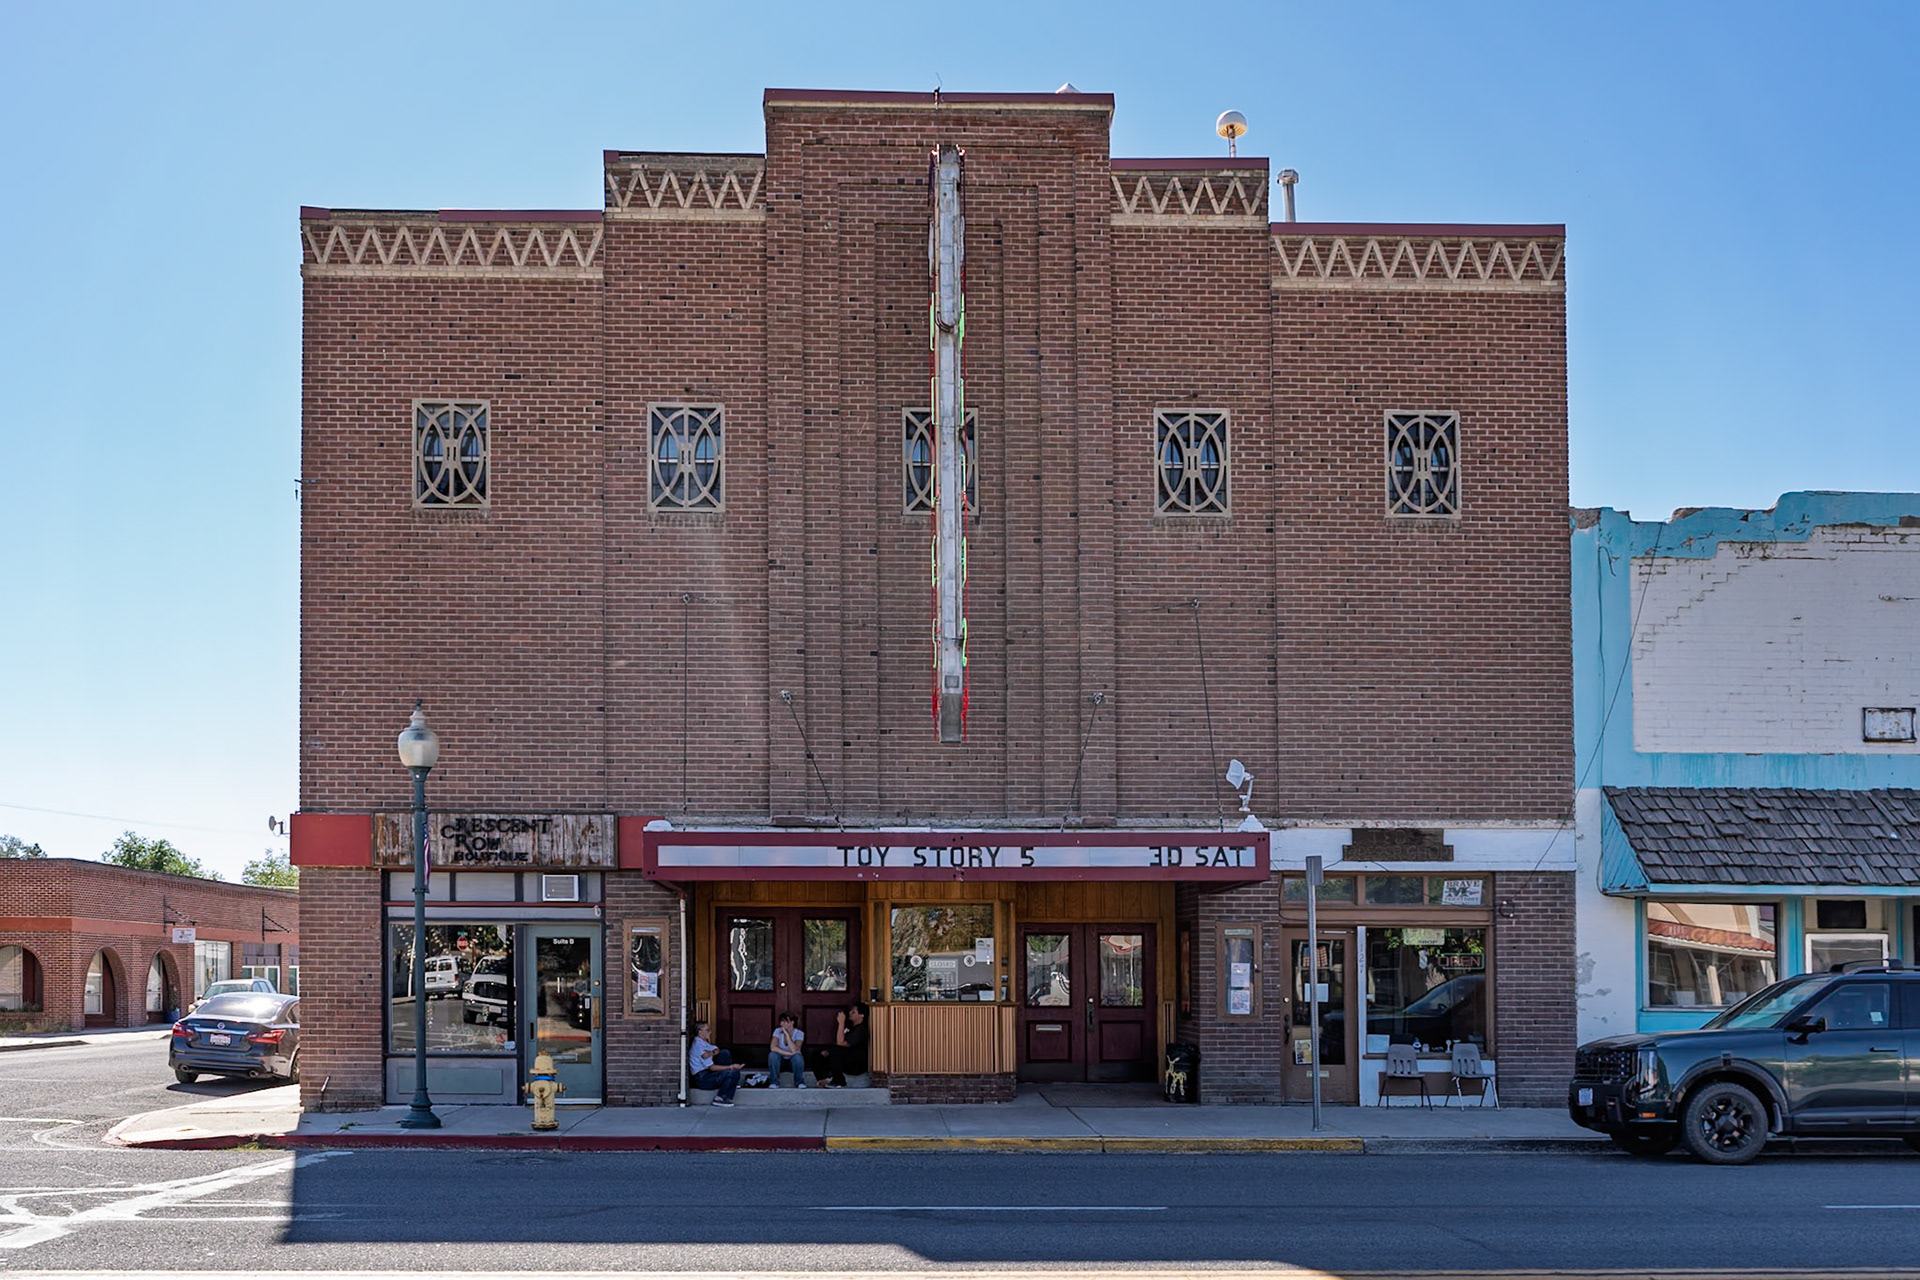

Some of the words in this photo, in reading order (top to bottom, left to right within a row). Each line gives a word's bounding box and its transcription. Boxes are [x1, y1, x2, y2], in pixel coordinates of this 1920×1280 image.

[441, 818, 552, 839] CRESCENT
[455, 833, 500, 851] ROW
[454, 852, 529, 862] BOUTIQUE
[837, 847, 889, 867] TOY
[914, 847, 999, 867] STORY
[1020, 847, 1034, 867] 5
[1195, 847, 1247, 867] SAT
